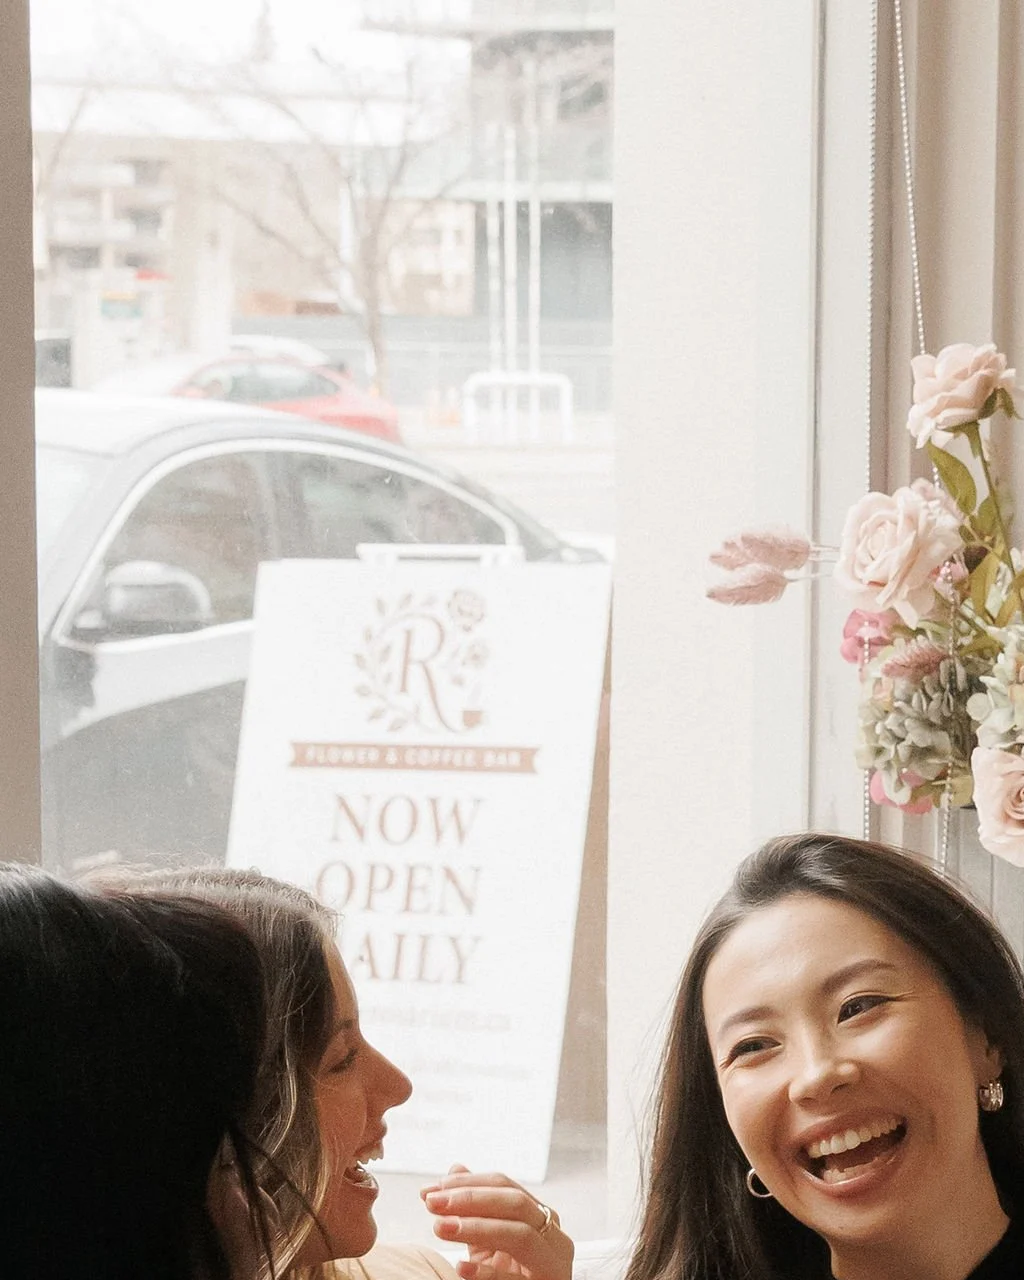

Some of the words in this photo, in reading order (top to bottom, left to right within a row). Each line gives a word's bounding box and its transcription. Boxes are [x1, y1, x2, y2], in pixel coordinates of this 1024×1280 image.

[396, 614, 458, 732] R
[331, 793, 483, 846] NOW
[316, 861, 481, 915] OPEN
[340, 932, 482, 984] AILY
